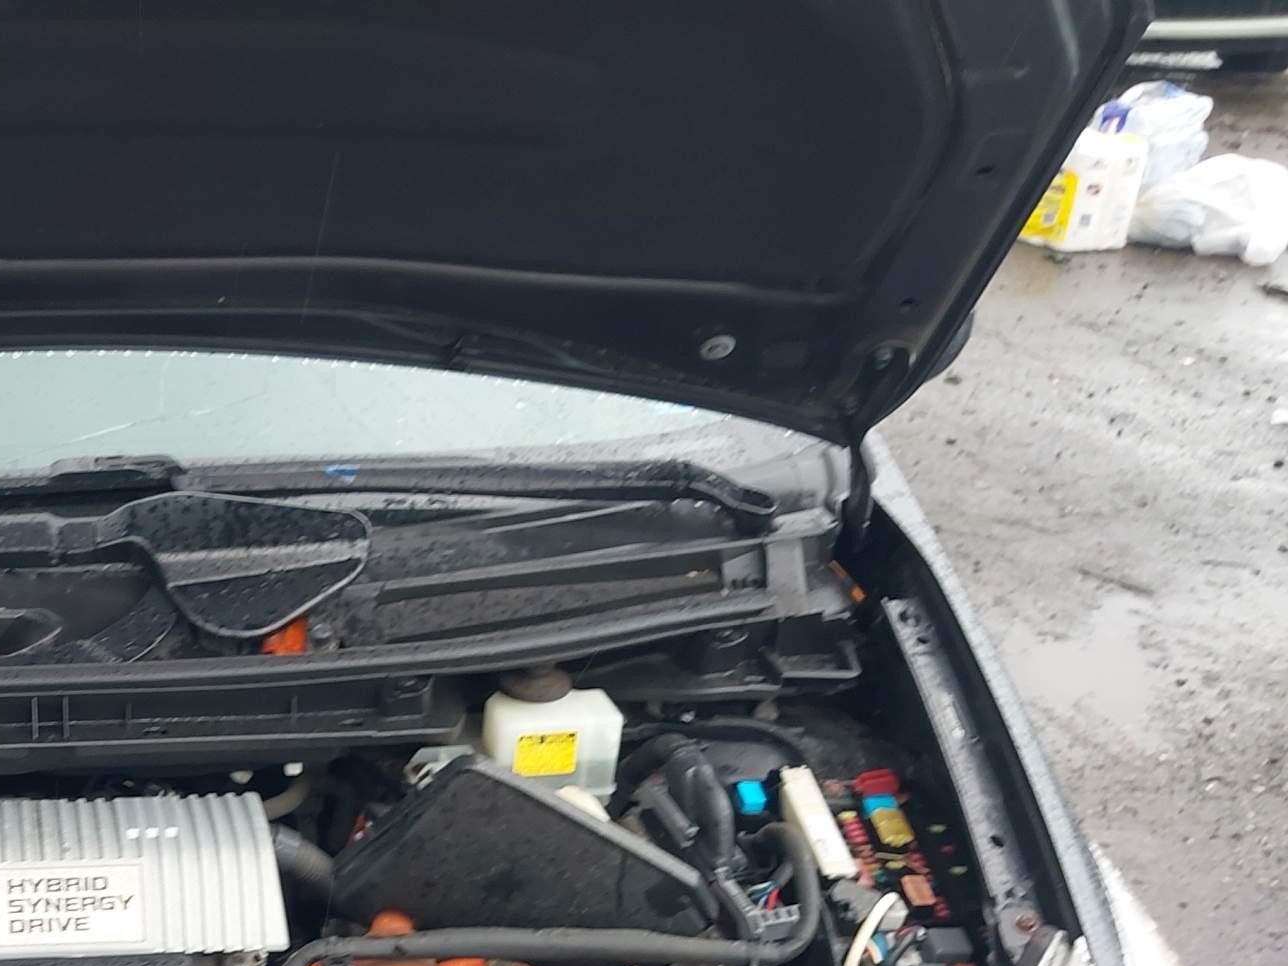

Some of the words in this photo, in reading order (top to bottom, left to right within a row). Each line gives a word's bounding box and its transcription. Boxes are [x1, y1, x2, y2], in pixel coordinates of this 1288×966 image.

[8, 876, 108, 894] HYBRID
[8, 895, 134, 914] SYNERGY
[9, 916, 90, 934] DRIVE
